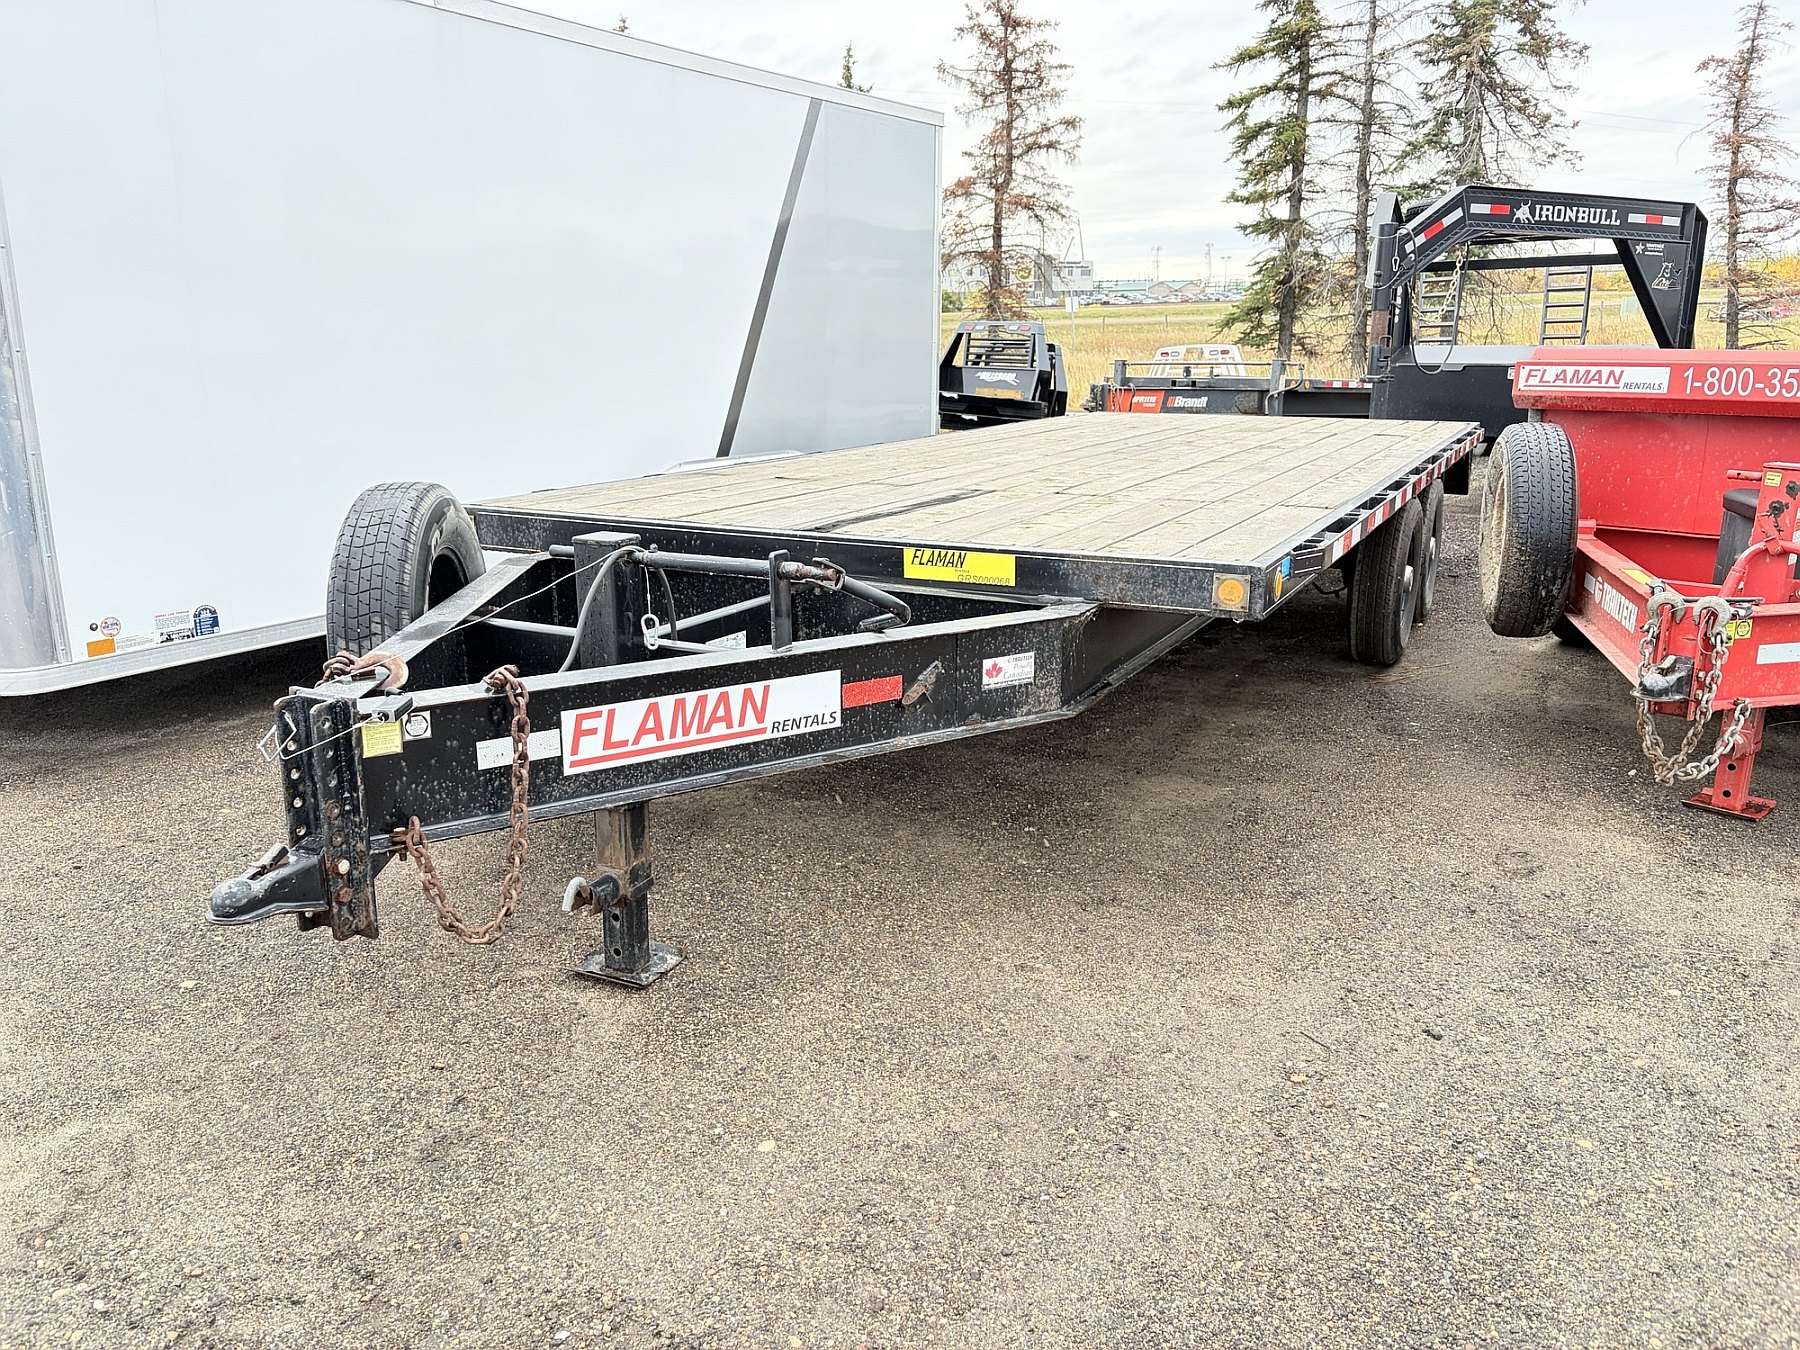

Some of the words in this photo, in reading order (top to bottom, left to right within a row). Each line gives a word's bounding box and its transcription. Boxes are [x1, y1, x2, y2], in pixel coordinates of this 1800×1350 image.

[1534, 204, 1621, 226] IRONBULL
[1524, 368, 1625, 385] FLAMAN
[1622, 381, 1663, 391] RENTALS
[1682, 366, 1800, 398] 1-800-35
[1174, 396, 1208, 408] Brandt
[911, 548, 967, 569] FLAMAN
[570, 684, 771, 757] FLAMAN
[771, 711, 837, 734] RENTALS
